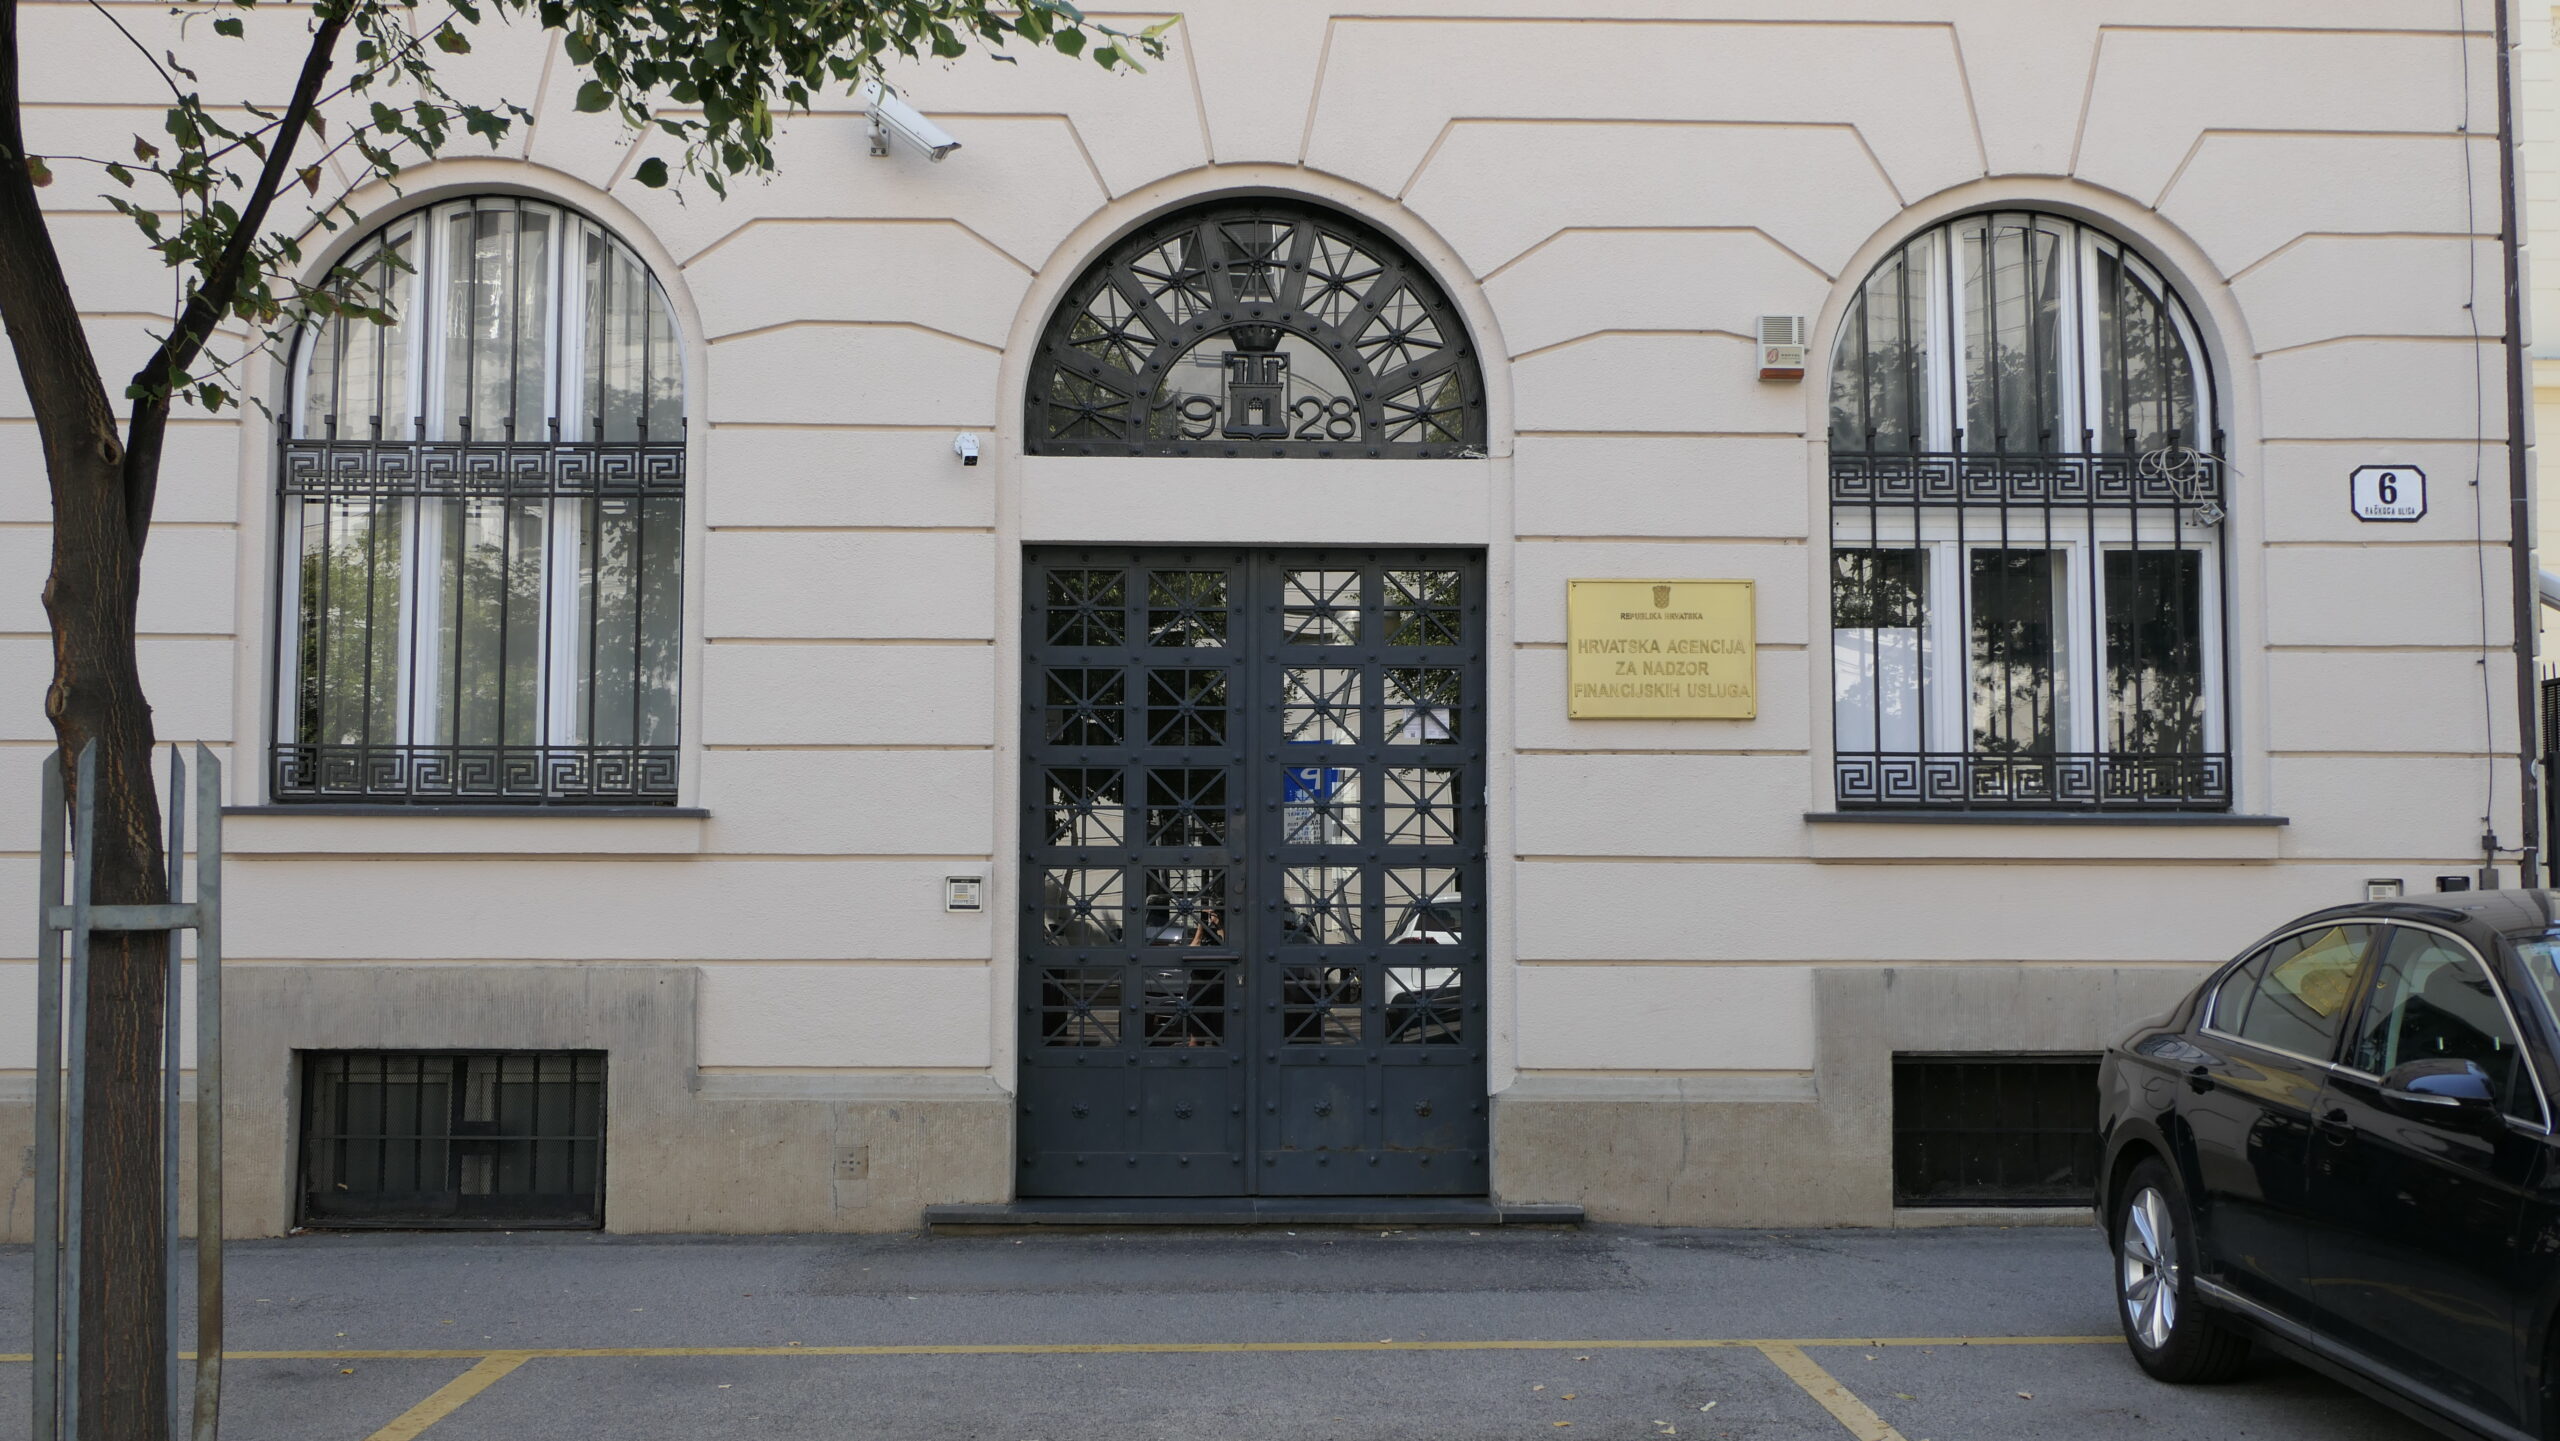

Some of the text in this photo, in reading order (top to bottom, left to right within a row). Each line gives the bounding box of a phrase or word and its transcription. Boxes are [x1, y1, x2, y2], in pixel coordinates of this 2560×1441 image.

[2378, 472, 2398, 505] 6
[2398, 506, 2416, 515] ULICA
[1620, 612, 1662, 620] REPUBLIKA
[1577, 639, 1746, 655] HRVATSKA AGENCIJA
[1615, 661, 1710, 676] ZA NADZOR
[1574, 683, 1751, 698] FINANCIJSKIH USLUGA
